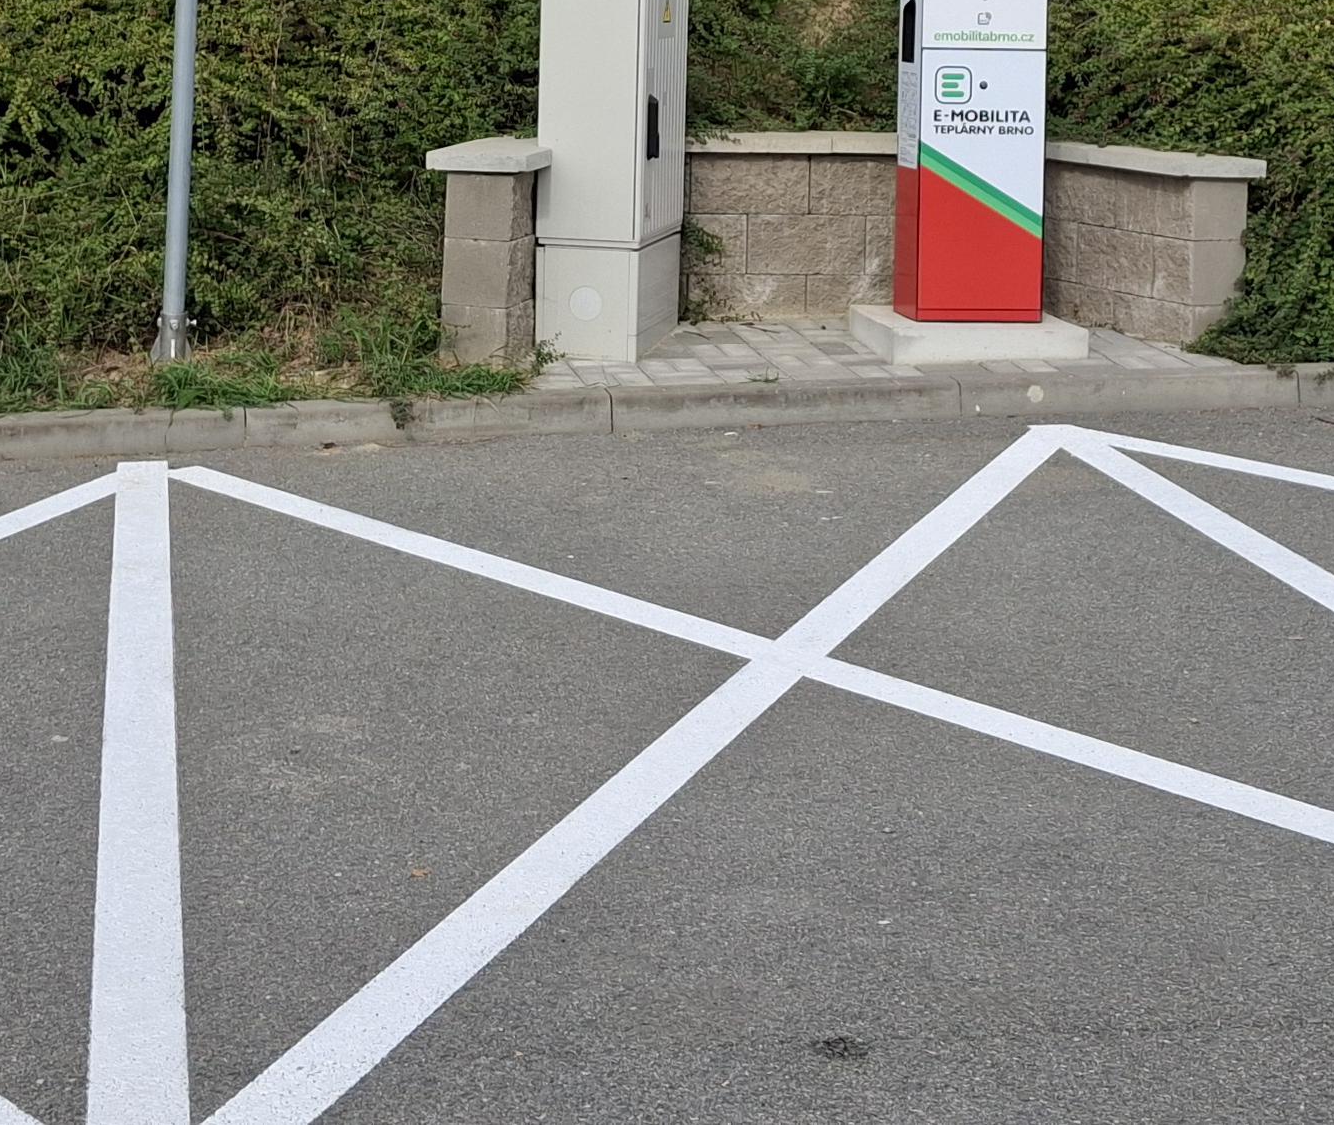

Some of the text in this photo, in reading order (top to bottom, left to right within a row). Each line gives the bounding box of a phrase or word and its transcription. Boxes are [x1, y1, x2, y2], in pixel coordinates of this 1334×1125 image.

[933, 30, 1035, 43] emobilitabrno.cz
[933, 109, 1031, 123] E-MOBILITA
[934, 122, 1035, 136] TEPLÁRNY BRNO
